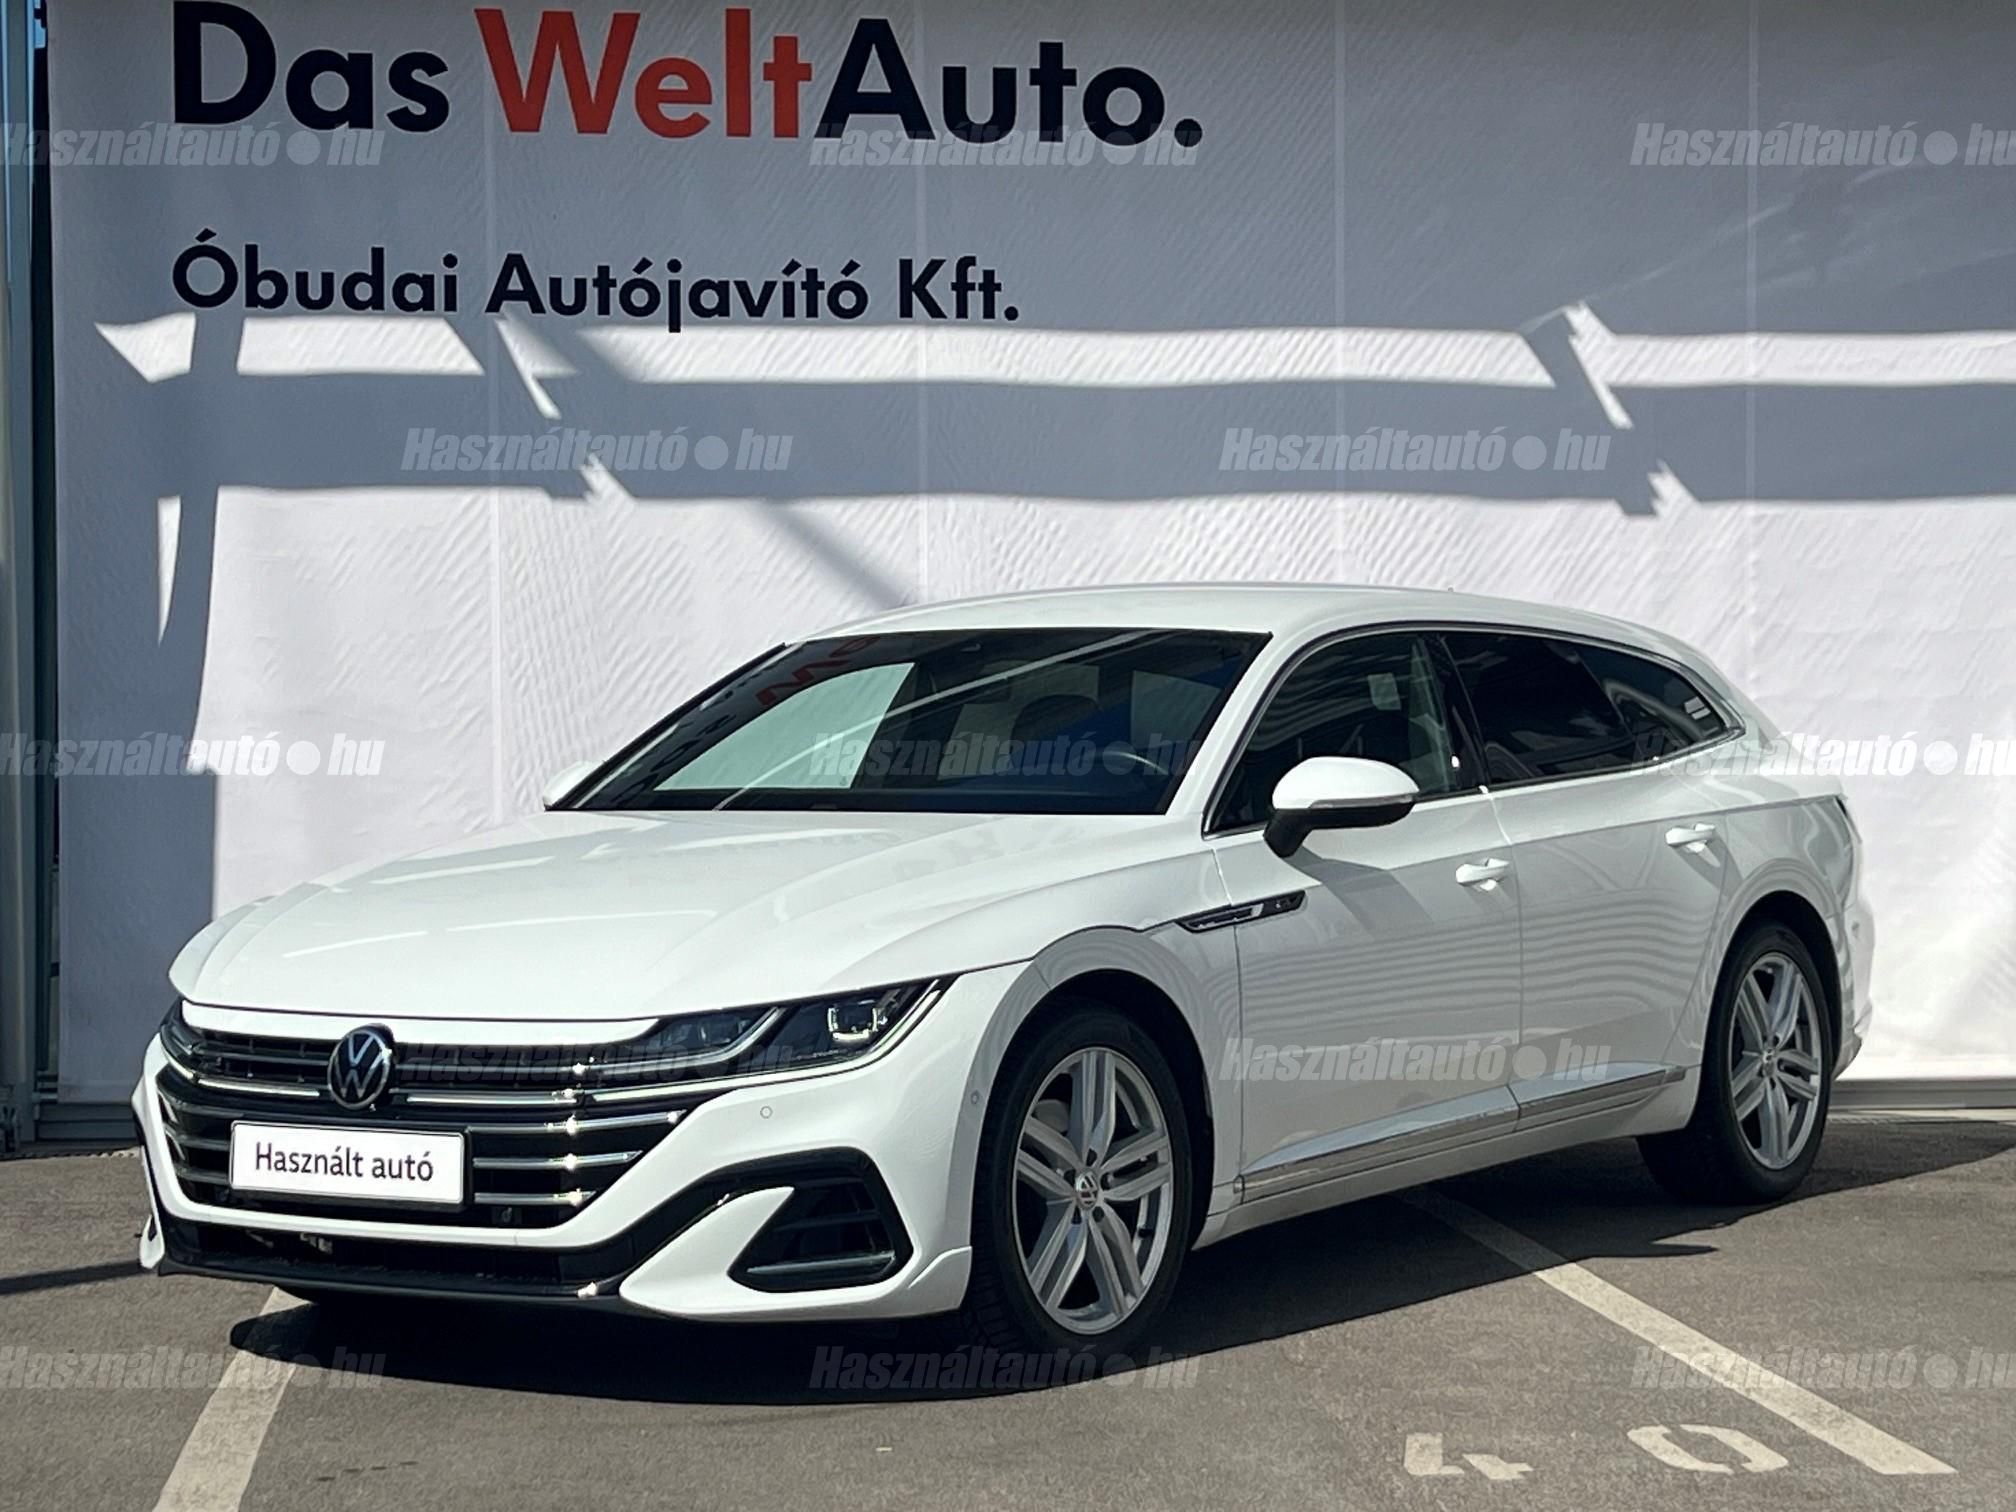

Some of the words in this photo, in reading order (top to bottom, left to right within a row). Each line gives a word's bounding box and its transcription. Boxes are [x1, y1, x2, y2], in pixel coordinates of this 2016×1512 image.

[174, 0, 450, 132] Das
[172, 228, 458, 313] Óbudai
[484, 253, 870, 333] Autójavító
[898, 255, 1020, 321] Kft.
[255, 1142, 364, 1178] Használt
[371, 1151, 434, 1181] autó
